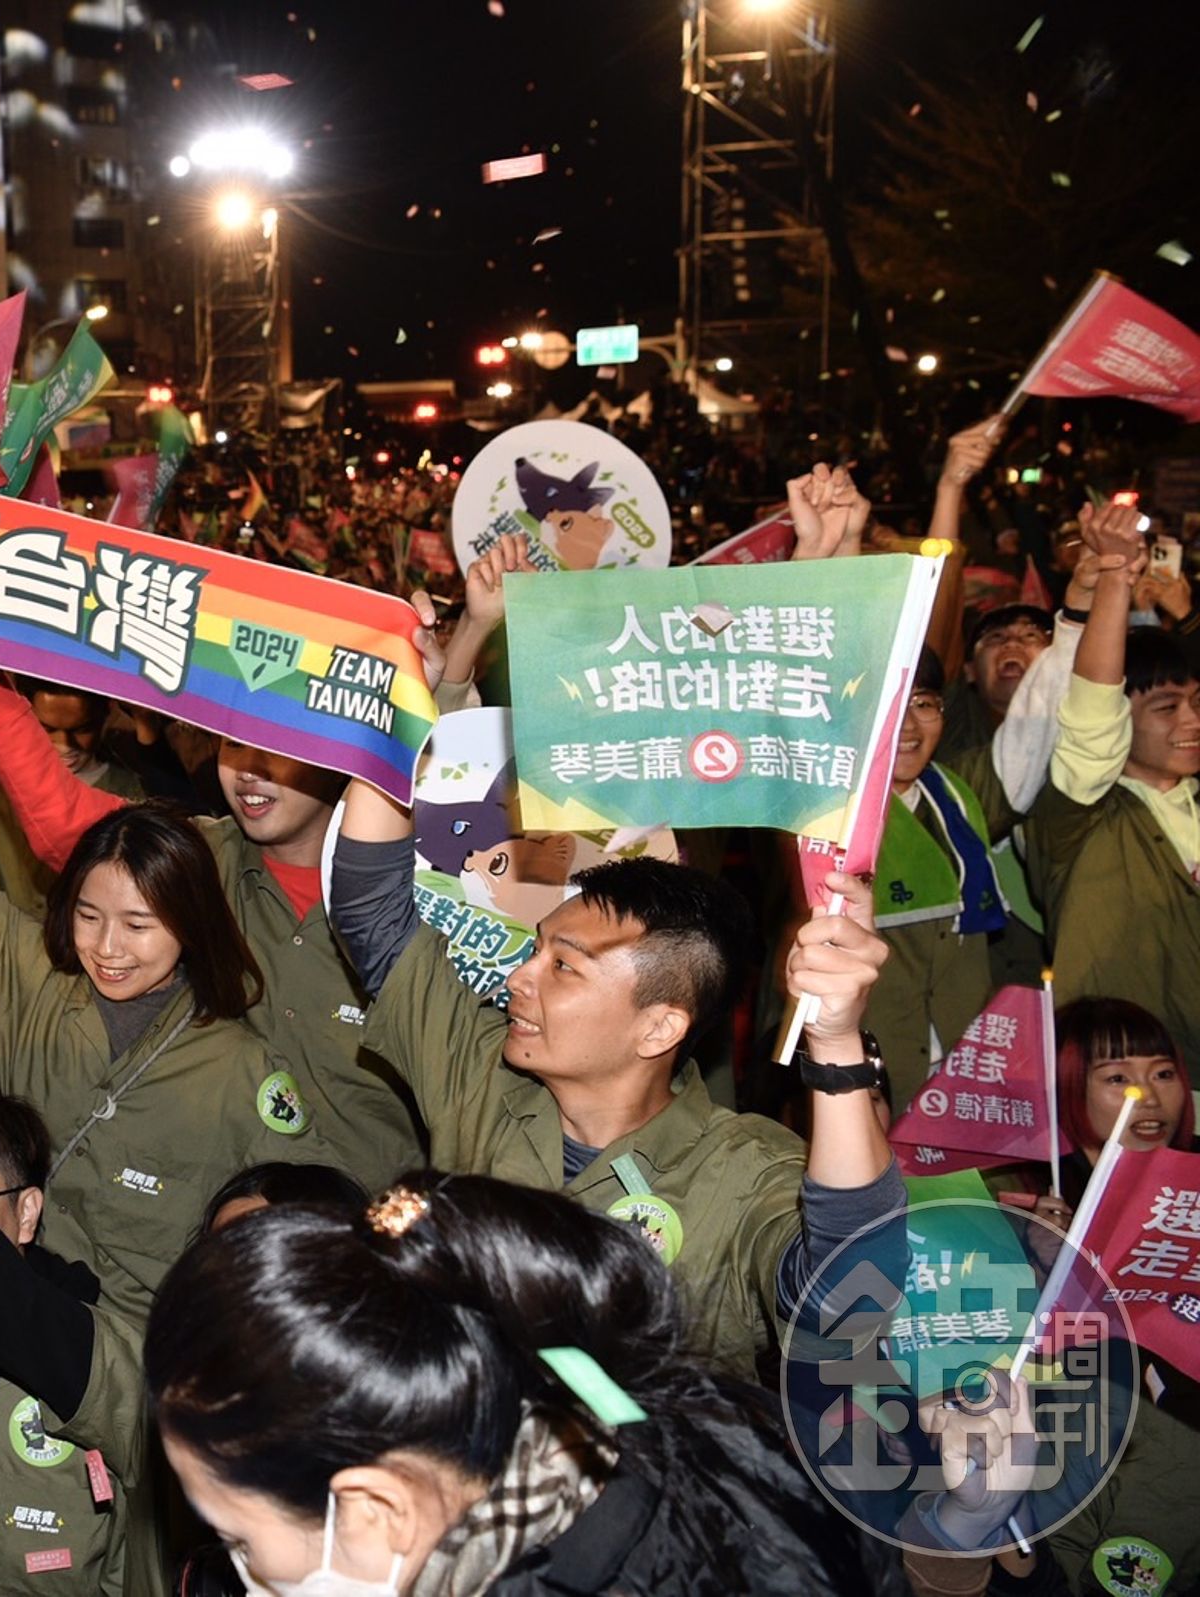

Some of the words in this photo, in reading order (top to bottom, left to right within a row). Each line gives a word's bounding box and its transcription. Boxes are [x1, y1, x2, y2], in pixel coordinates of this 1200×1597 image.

[234, 625, 299, 668] 2024
[329, 648, 394, 694] TEAM
[308, 679, 394, 734] TAIWAN
[1102, 1288, 1169, 1303] 2024
[891, 1308, 1013, 1355] 蕭美琴
[36, 1525, 59, 1533] Taiwan
